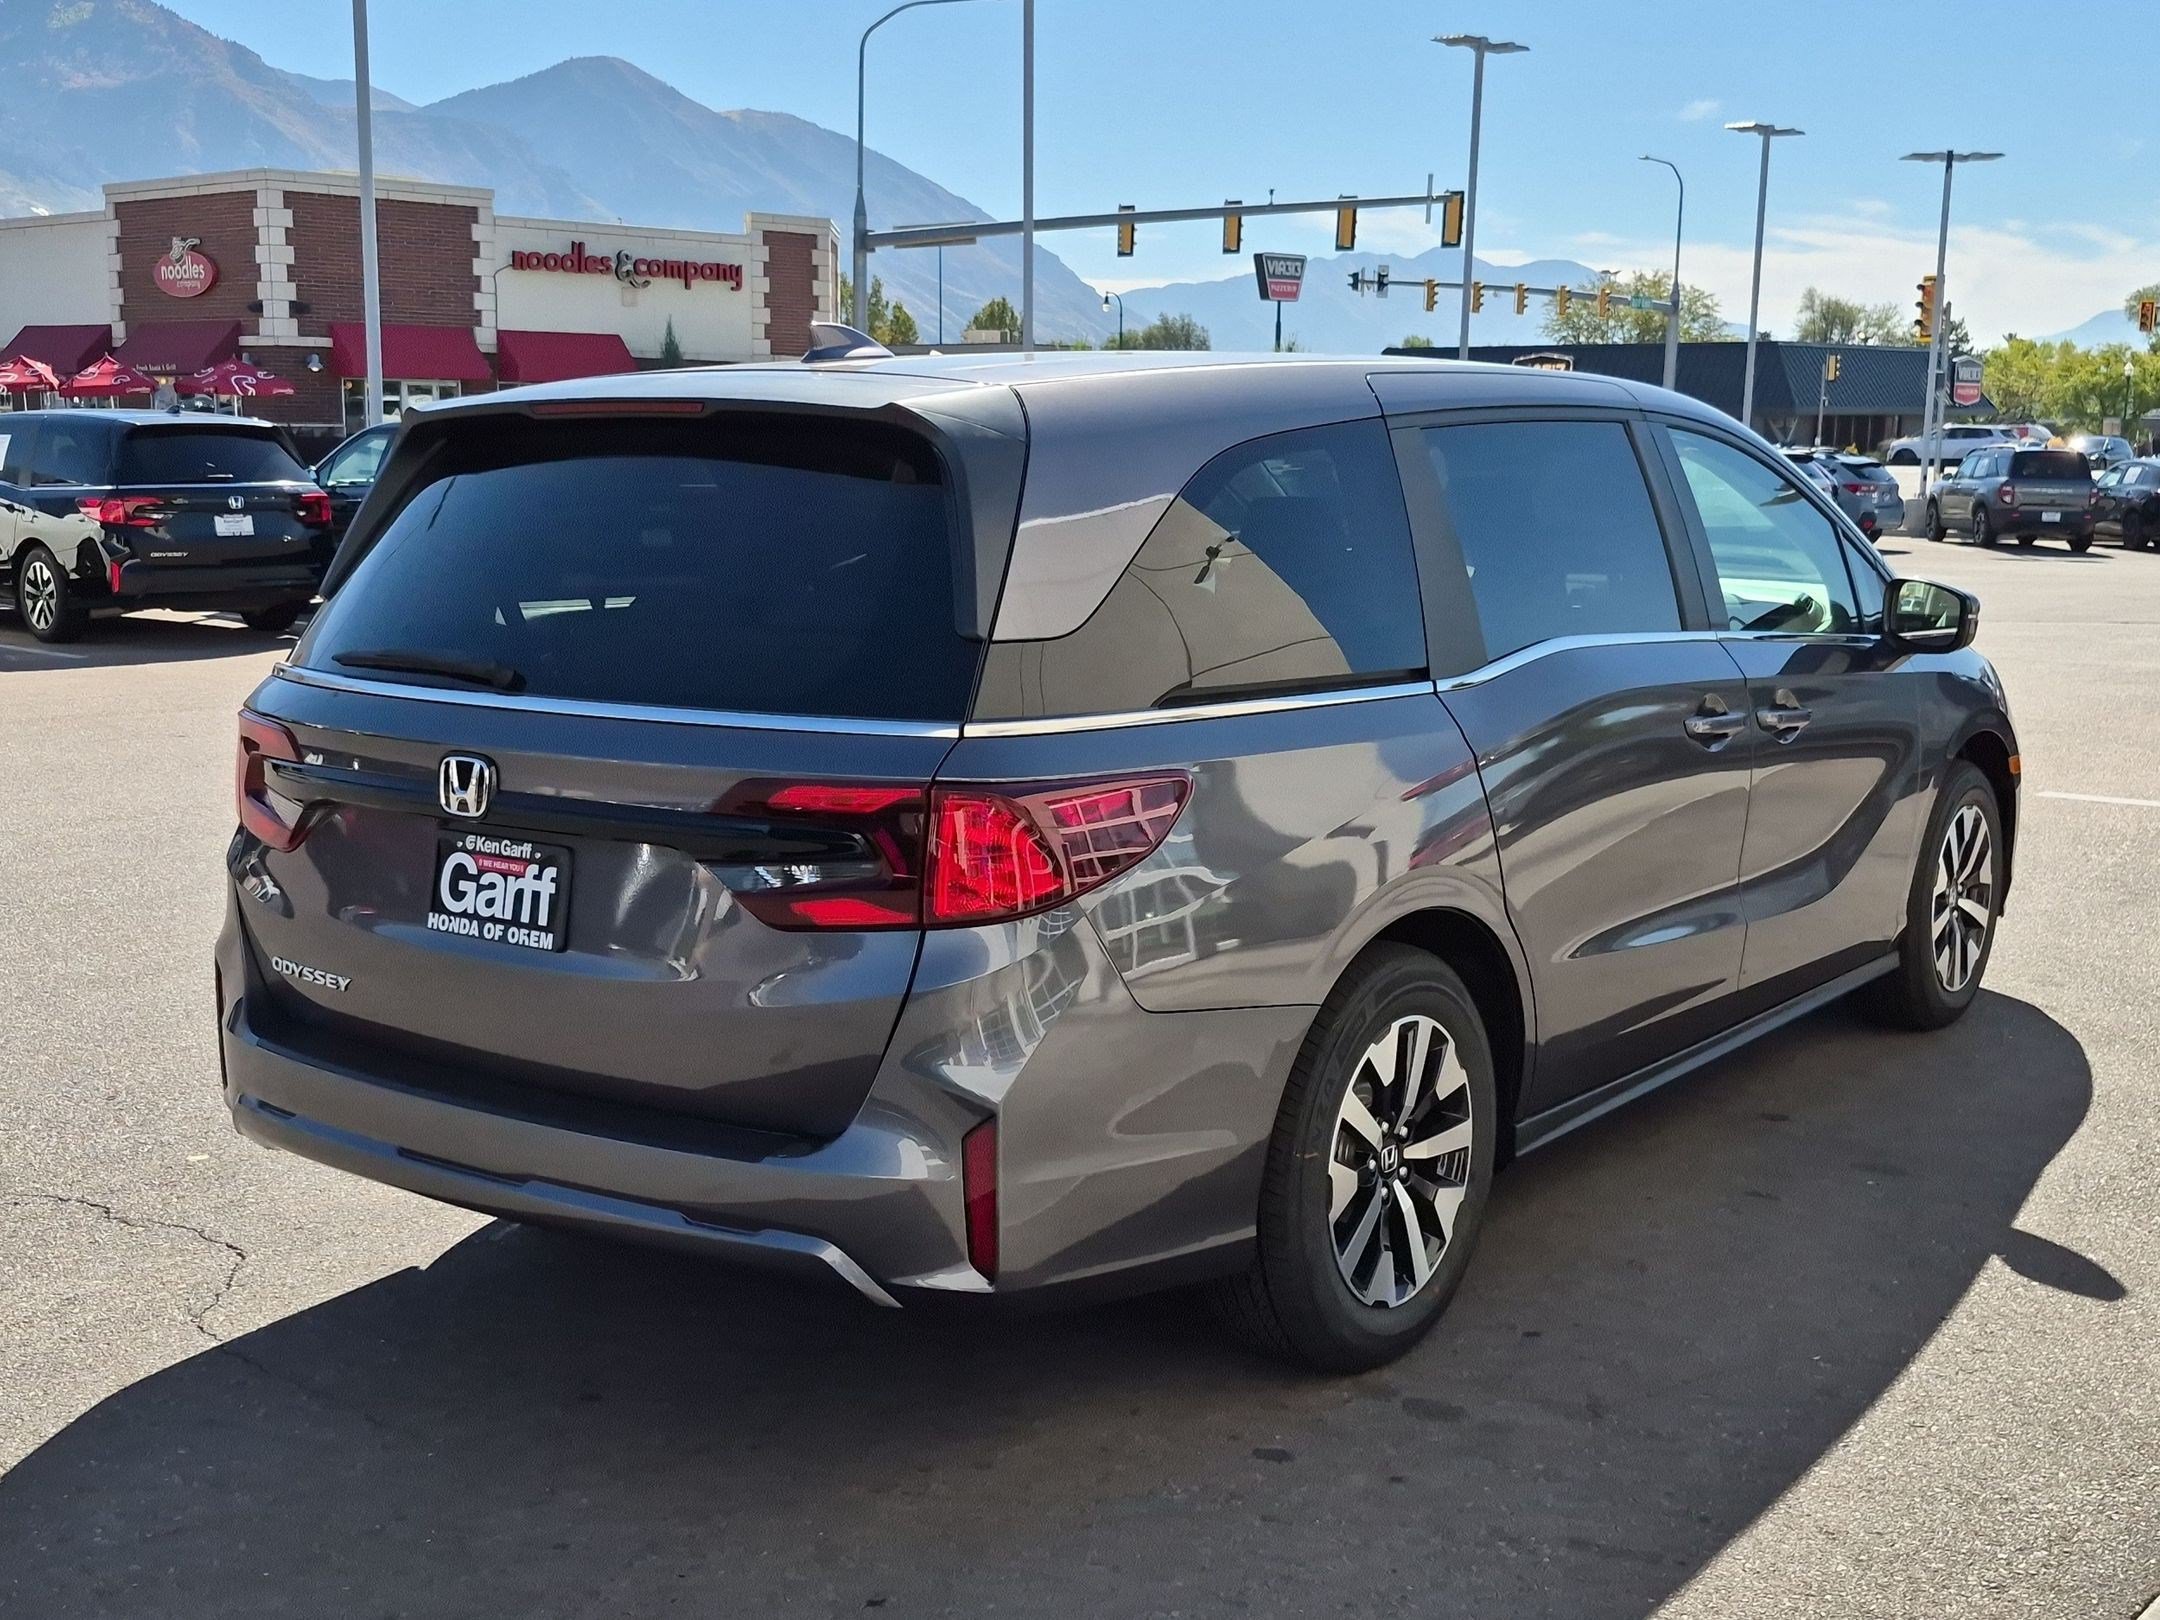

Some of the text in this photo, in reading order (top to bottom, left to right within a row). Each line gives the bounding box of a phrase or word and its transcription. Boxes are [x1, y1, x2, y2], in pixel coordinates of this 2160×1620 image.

[161, 254, 205, 280] noodles
[511, 240, 612, 275] noodles
[632, 257, 743, 291] company
[476, 836, 532, 859] Ken Garff
[440, 851, 557, 927] Garff
[427, 912, 554, 950] HONDA OF OREM
[271, 955, 352, 992] ODYSSEY
